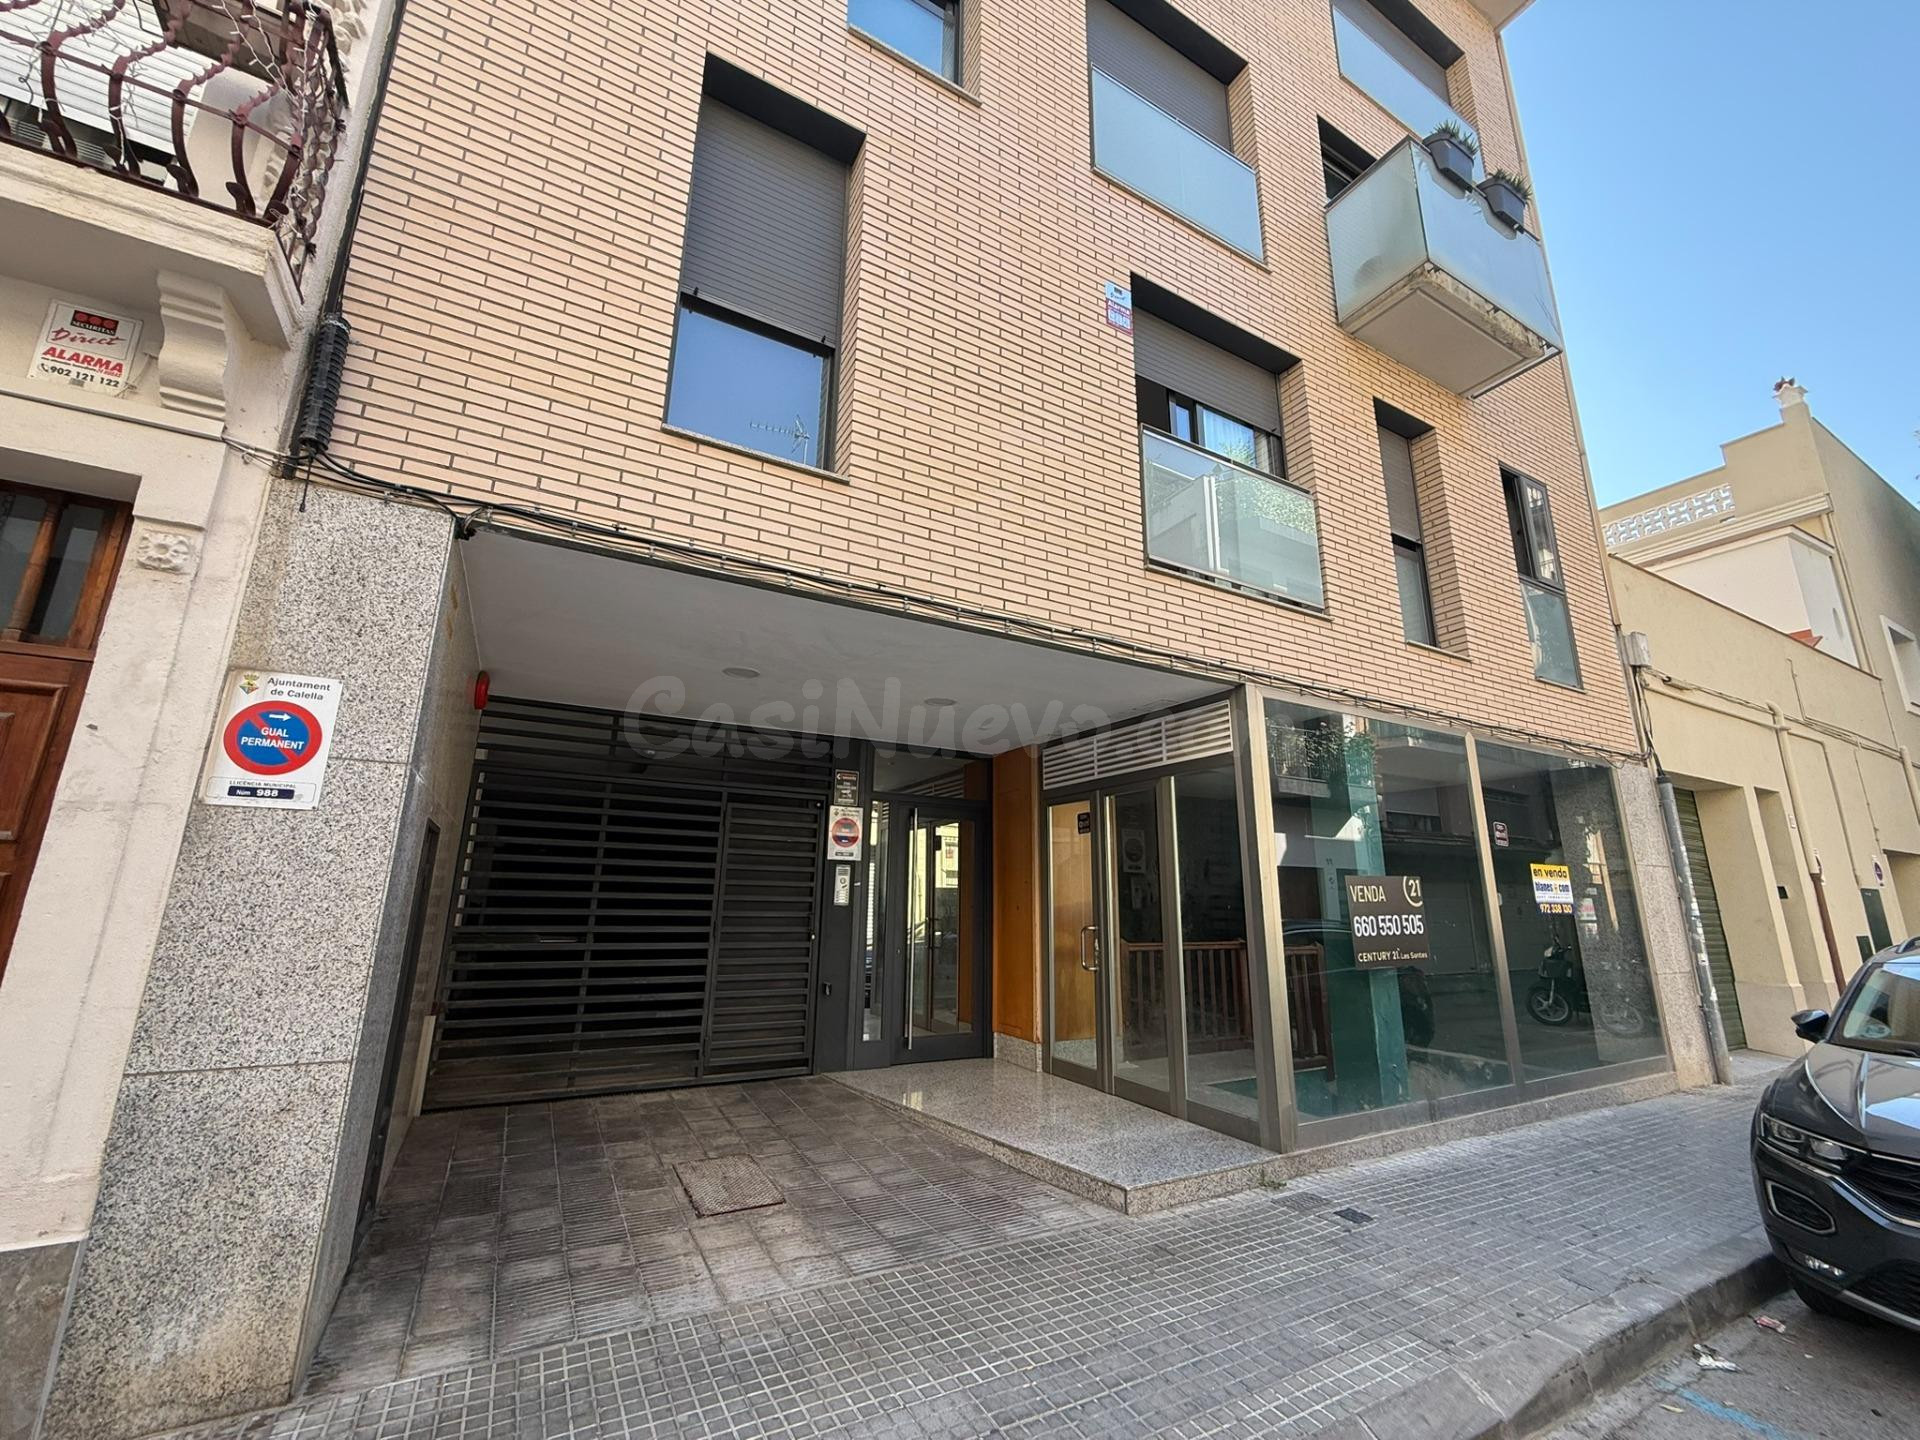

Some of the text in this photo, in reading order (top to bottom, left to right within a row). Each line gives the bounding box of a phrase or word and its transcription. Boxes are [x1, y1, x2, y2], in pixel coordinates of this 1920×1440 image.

[71, 320, 116, 336] SECURITAS
[51, 327, 127, 346] Direct
[41, 346, 124, 373] ALARMA
[50, 365, 72, 377] 902
[75, 371, 95, 382] 121
[99, 376, 120, 388] 122
[267, 677, 330, 691] Ajuntament
[270, 688, 324, 701] de Calella
[260, 727, 289, 737] GUAL
[240, 736, 304, 750] PERMANENT
[256, 788, 279, 797] 988
[1533, 867, 1567, 878] en venda
[1350, 885, 1387, 902] VENDA
[1353, 914, 1424, 937] 660 550 505
[1358, 951, 1391, 962] CENTURY
